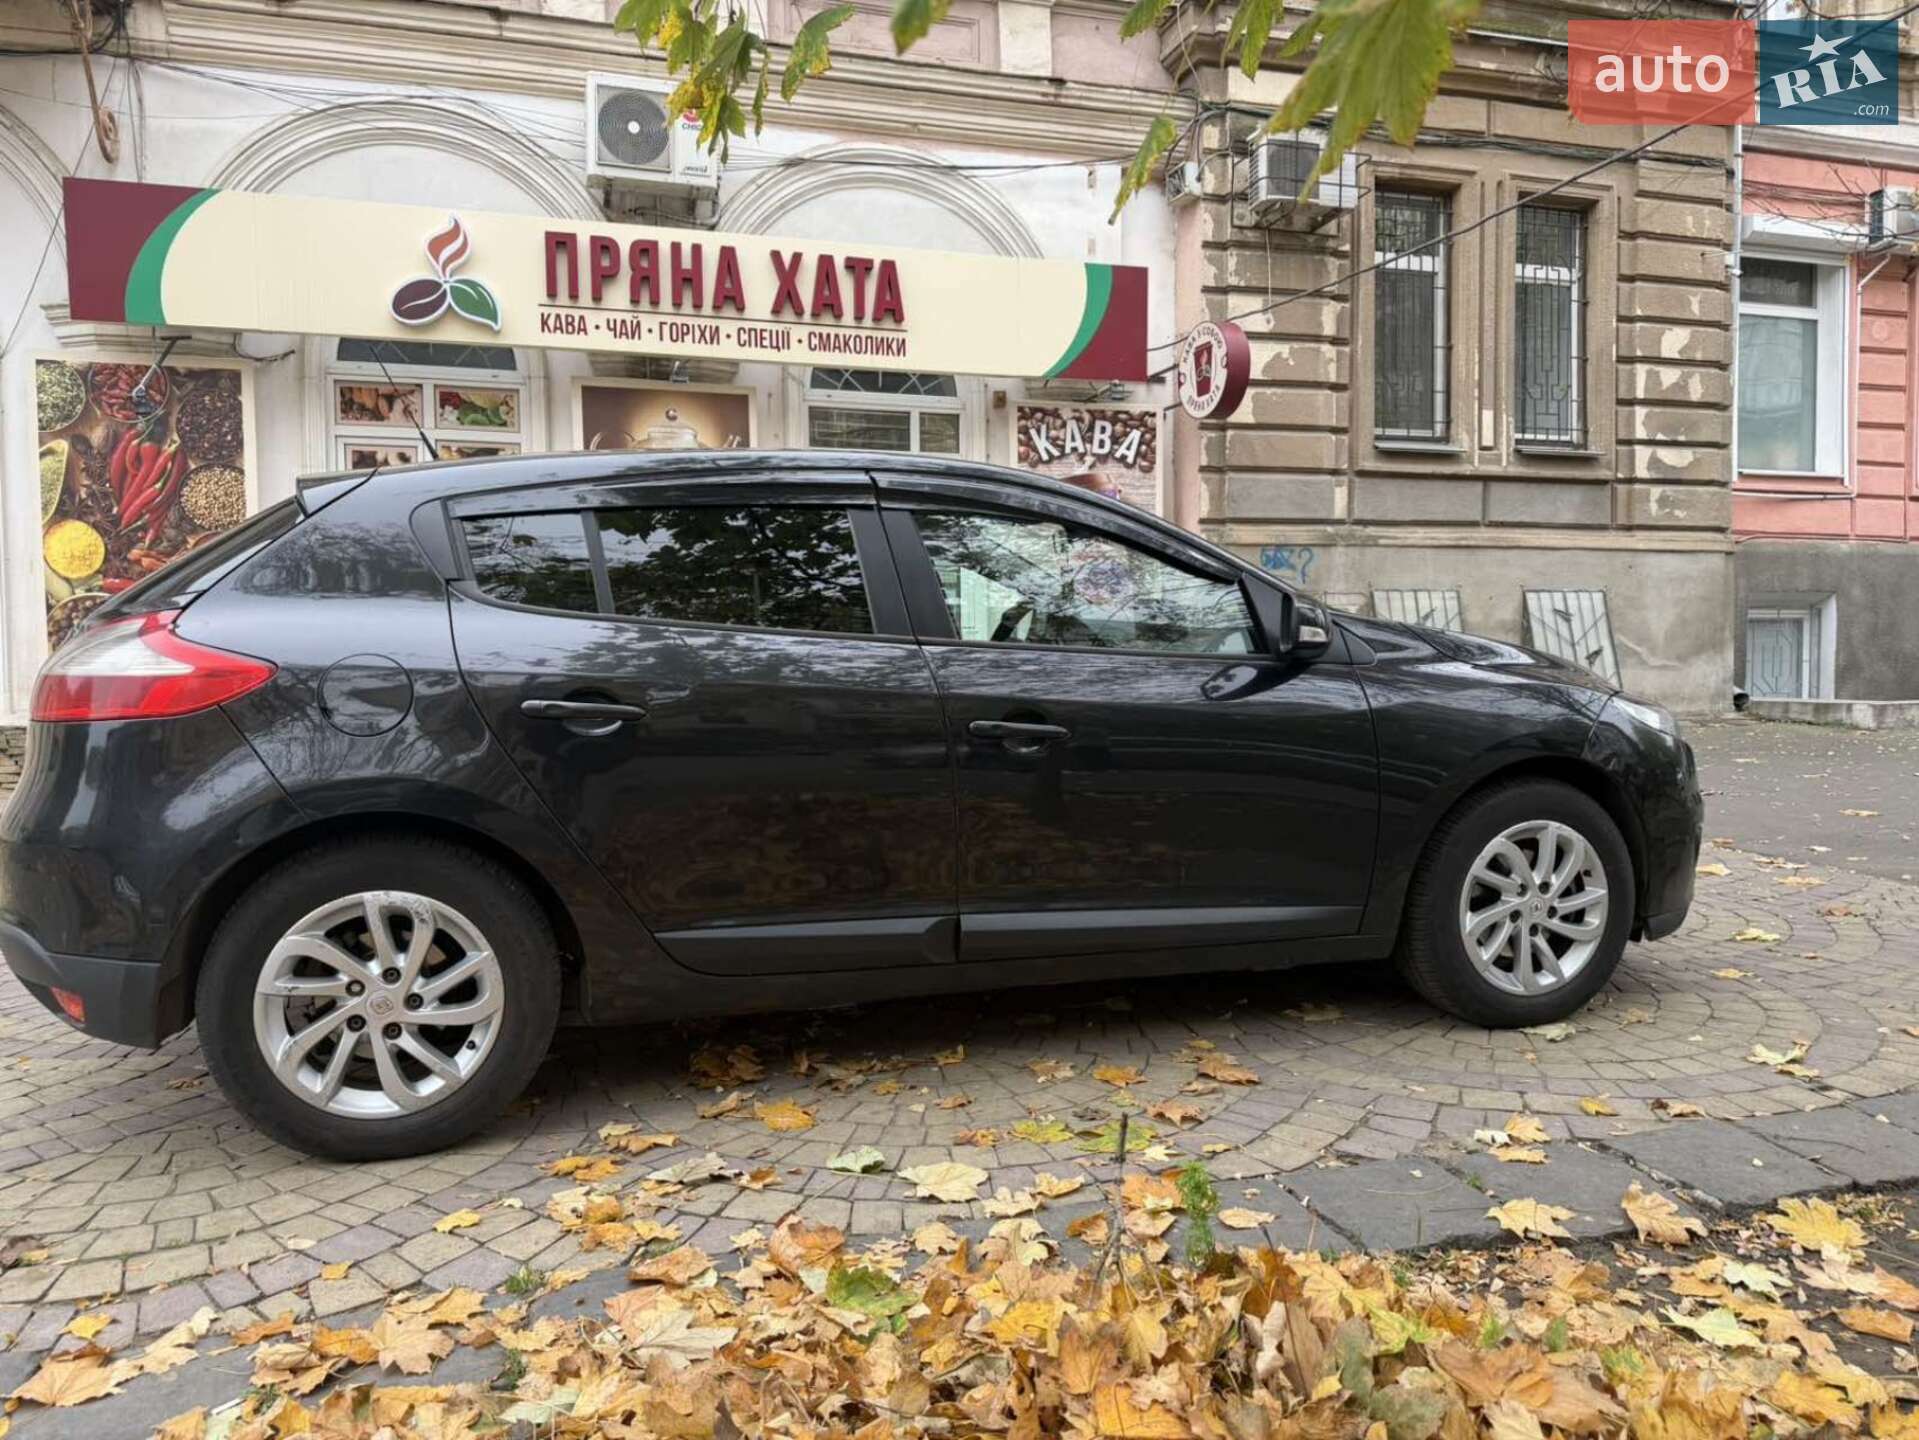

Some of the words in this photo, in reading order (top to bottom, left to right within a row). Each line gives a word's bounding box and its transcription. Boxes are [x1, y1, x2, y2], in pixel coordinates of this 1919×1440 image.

[545, 230, 746, 310] ПРЯНА
[769, 249, 905, 323] ХАТА
[540, 312, 588, 336] КАВА
[606, 314, 642, 341] ЧАЙ
[658, 321, 720, 346] ГОРІХИ
[737, 326, 791, 352] СПЕЦІЇ
[808, 331, 907, 358] СМАКОЛИКИ
[1029, 419, 1142, 465] КАВА
